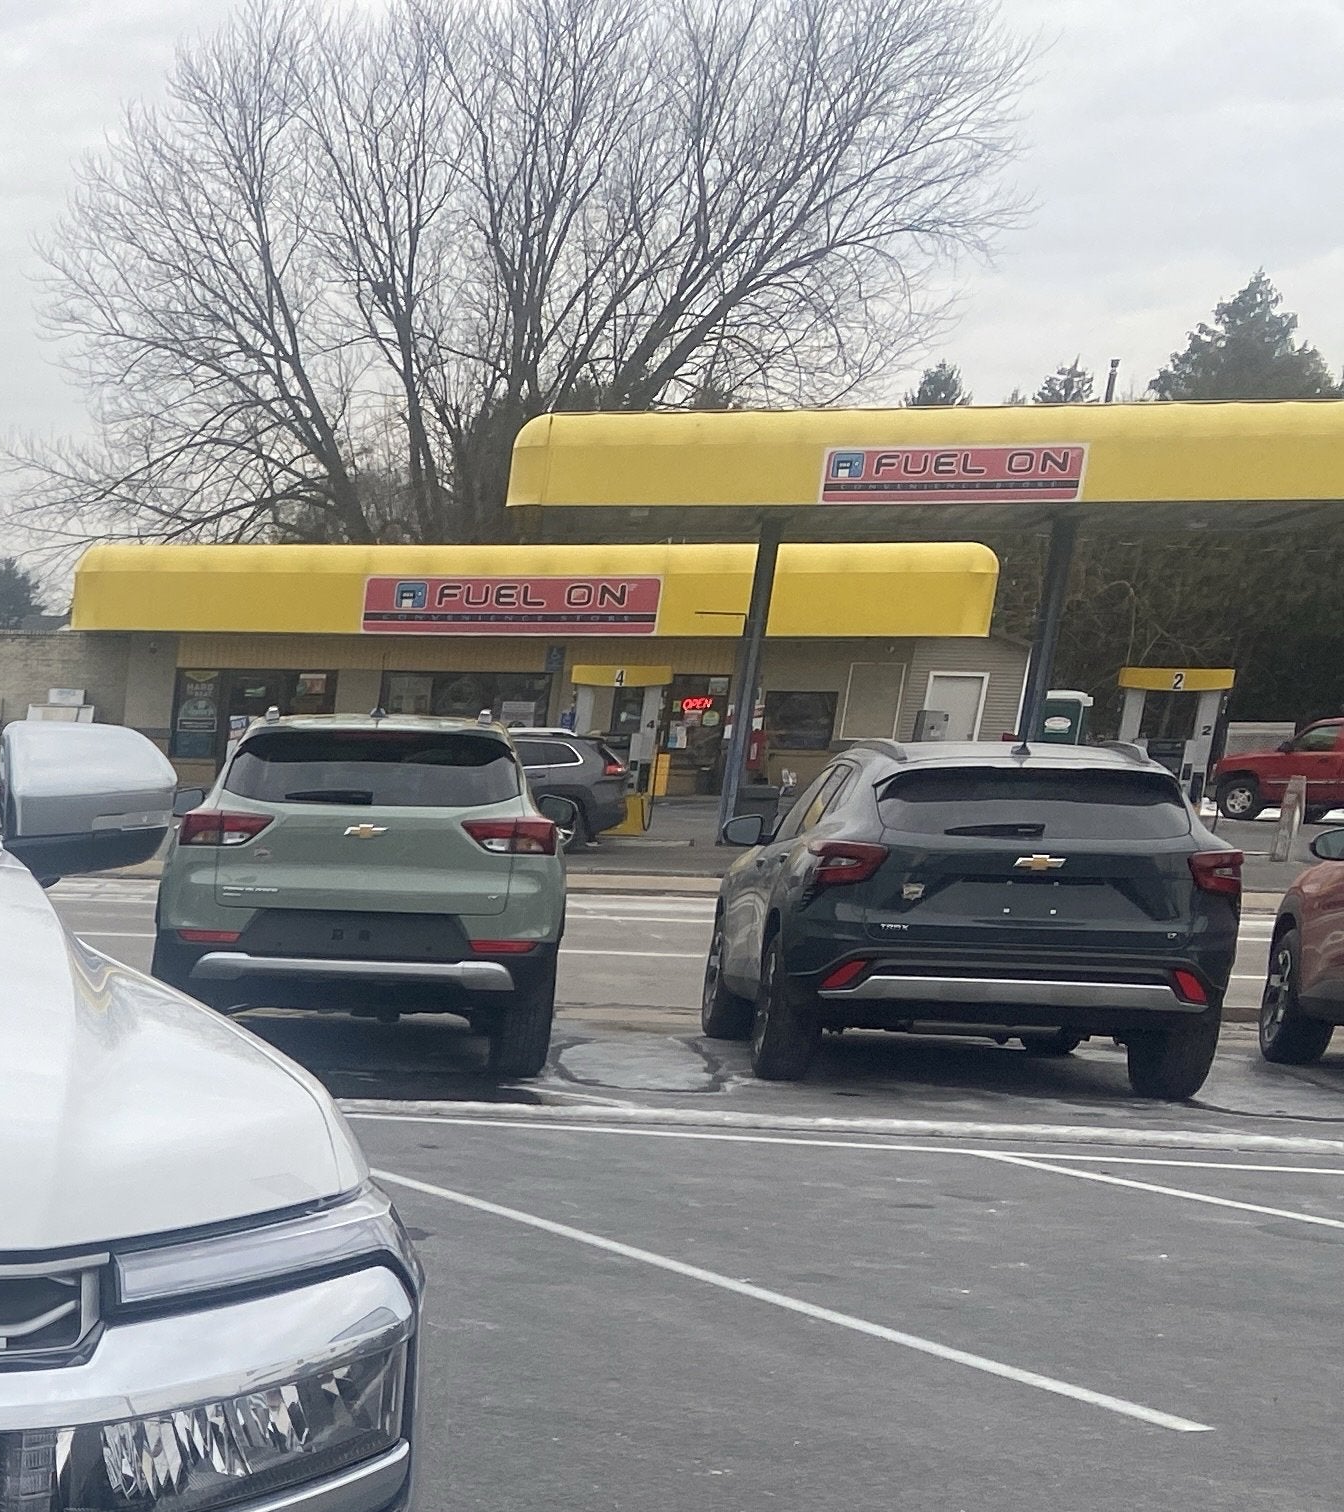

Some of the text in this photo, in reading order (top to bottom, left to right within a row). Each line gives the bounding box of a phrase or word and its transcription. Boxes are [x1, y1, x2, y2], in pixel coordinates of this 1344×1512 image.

[873, 450, 1072, 477] FUEL ON
[435, 583, 630, 608] FUEL ON
[615, 670, 625, 686] 4
[1172, 673, 1184, 690] 2
[682, 697, 714, 711] OPEN
[646, 720, 655, 729] 4
[1202, 725, 1212, 735] 2
